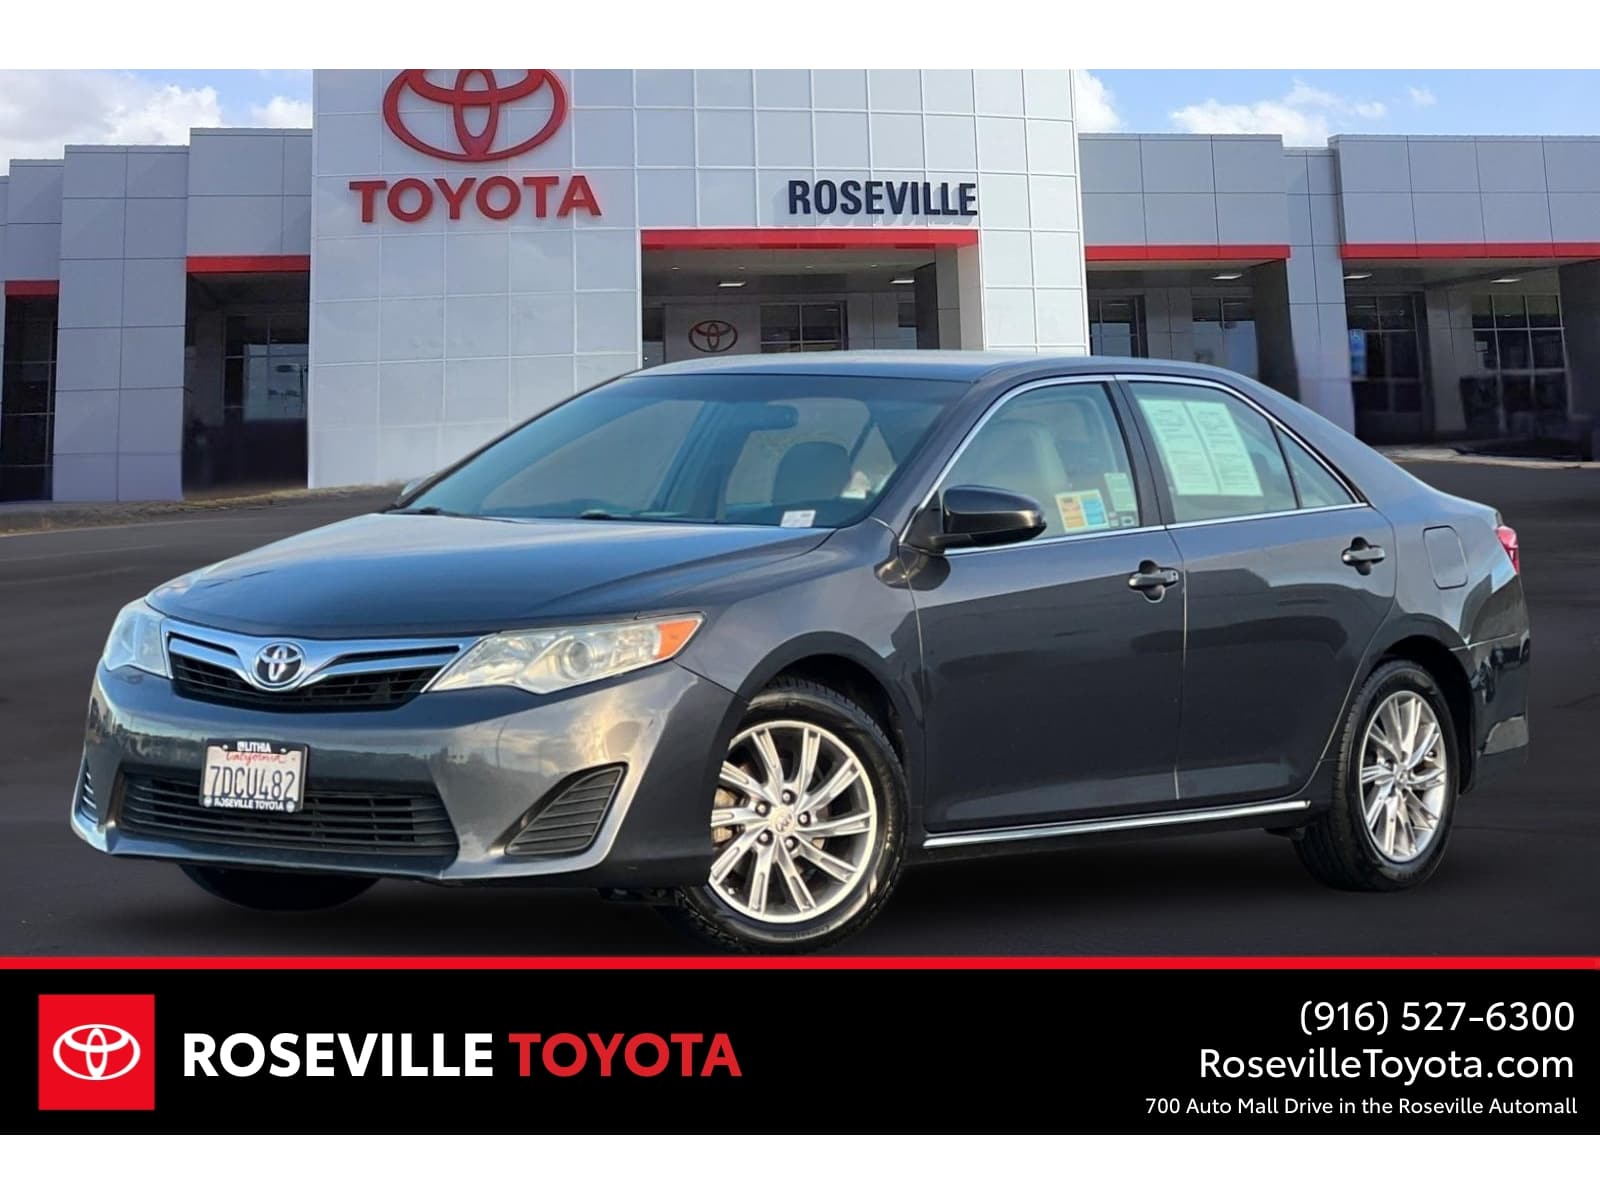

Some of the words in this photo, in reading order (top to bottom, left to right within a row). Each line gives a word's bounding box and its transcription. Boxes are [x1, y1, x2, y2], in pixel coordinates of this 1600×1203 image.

[349, 175, 601, 222] TOYOTA
[788, 179, 978, 216] ROSEVILLE
[209, 765, 295, 801] 7DCU482
[255, 800, 284, 811] TOYOTA
